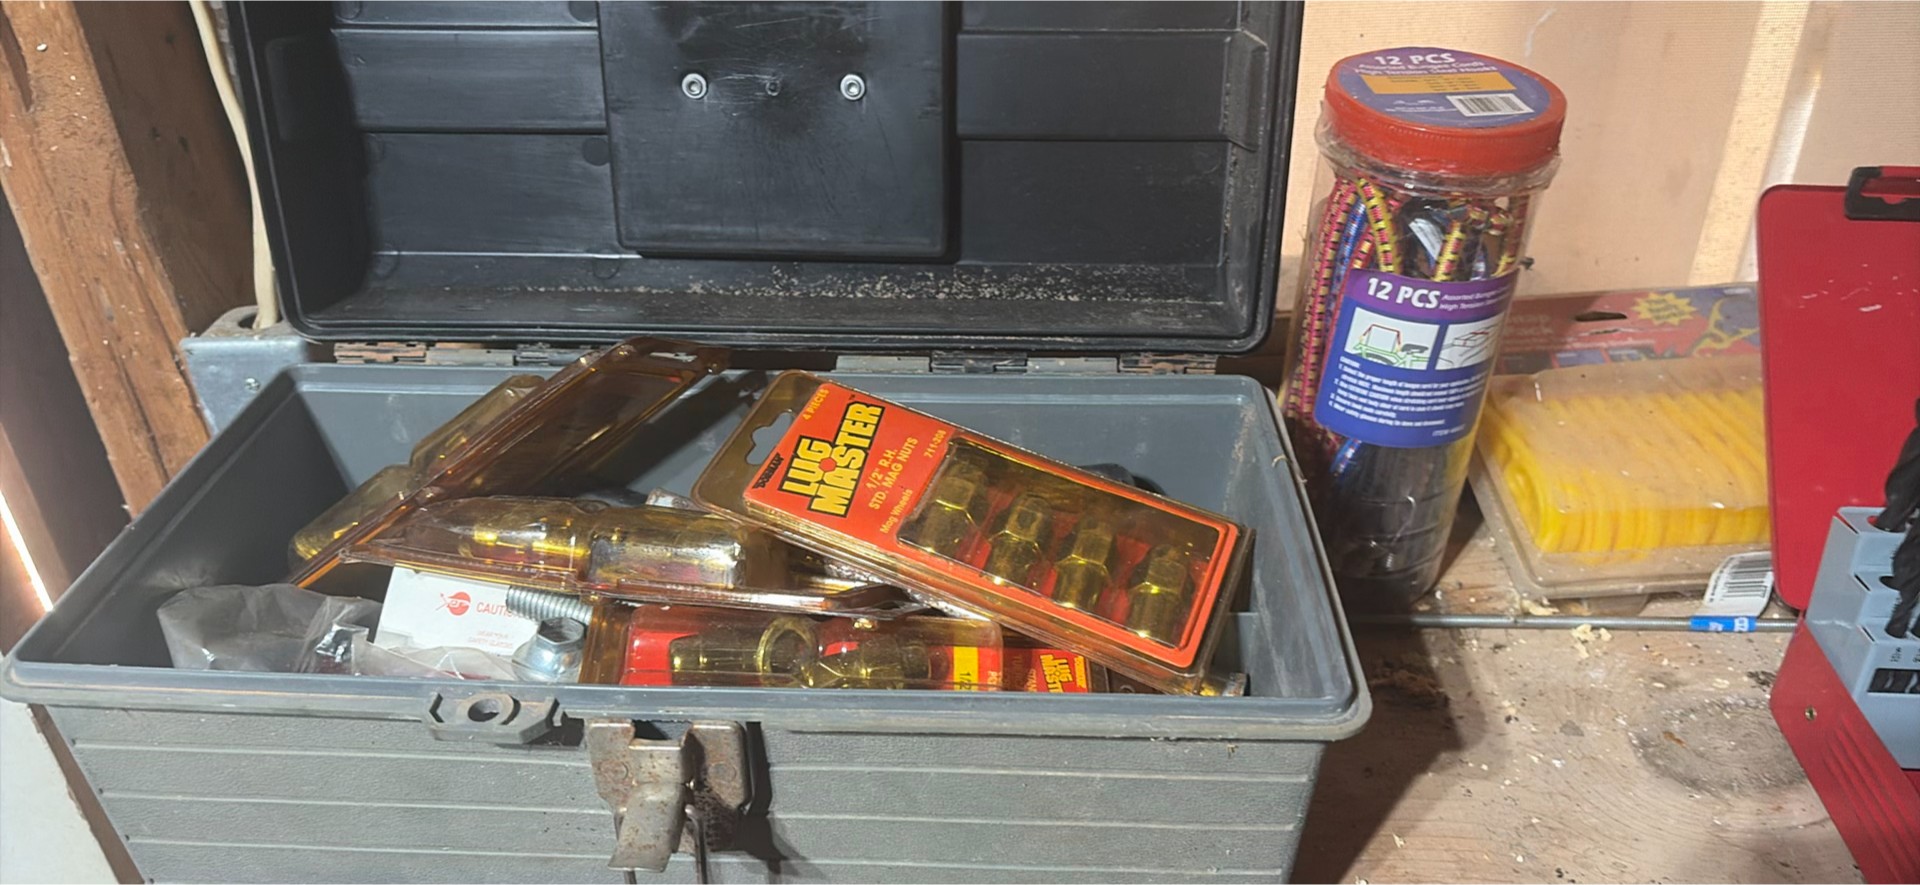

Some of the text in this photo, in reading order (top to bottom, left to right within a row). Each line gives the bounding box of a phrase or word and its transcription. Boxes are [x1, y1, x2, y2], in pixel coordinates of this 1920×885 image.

[1374, 53, 1456, 65] 12 PCS
[1367, 277, 1441, 309] 12 PCS
[802, 388, 830, 421] 4 PIECES
[780, 437, 834, 497] LUG
[809, 400, 882, 515] MASTER
[865, 449, 898, 489] 1/2" R.H.
[868, 437, 918, 510] STD. MAG NUTS
[880, 488, 914, 534] Mag Wheels
[1058, 658, 1073, 683] LUG
